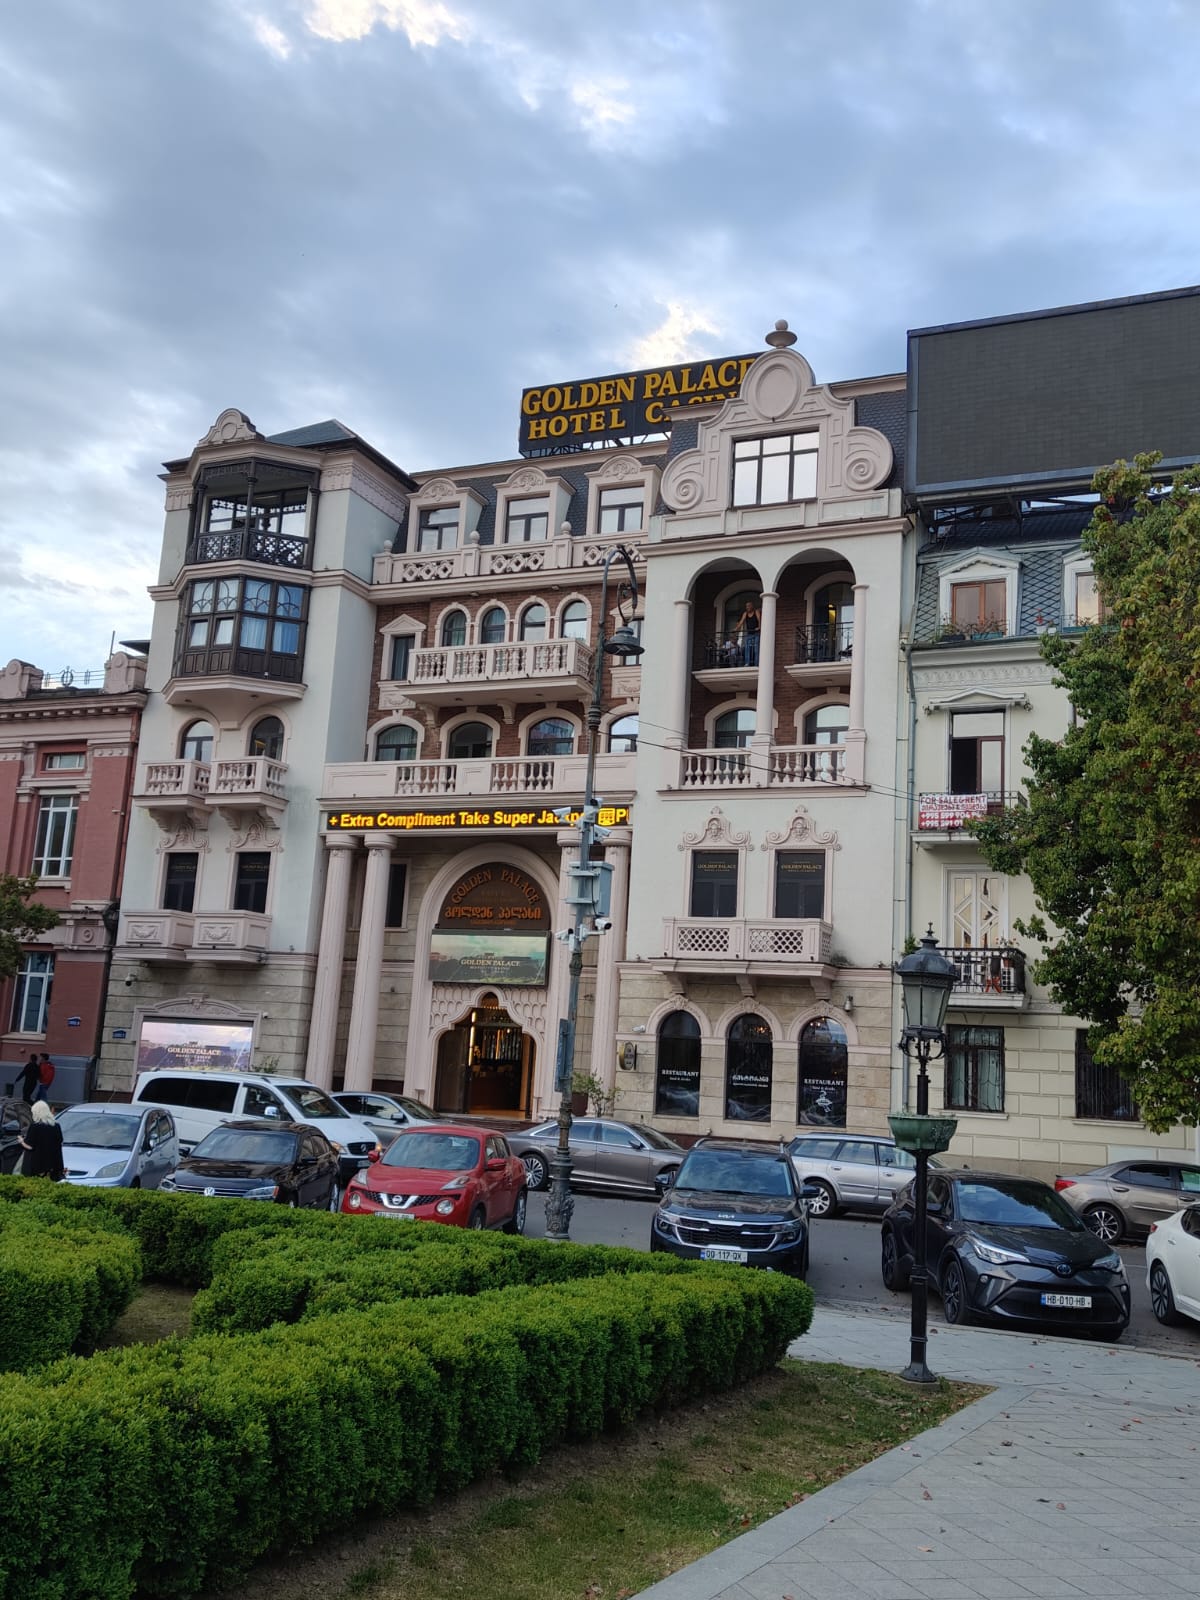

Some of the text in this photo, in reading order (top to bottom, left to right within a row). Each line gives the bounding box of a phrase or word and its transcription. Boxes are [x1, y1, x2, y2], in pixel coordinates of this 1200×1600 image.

[522, 376, 637, 415] GOLDEN
[528, 408, 626, 440] HOTEL
[341, 814, 374, 827] Extra
[459, 811, 490, 825] Take
[494, 810, 536, 828] Super
[451, 869, 540, 904] GOLDEN PALACE
[661, 1069, 699, 1077] RESTAURANT
[803, 1078, 845, 1086] RESTAURANT
